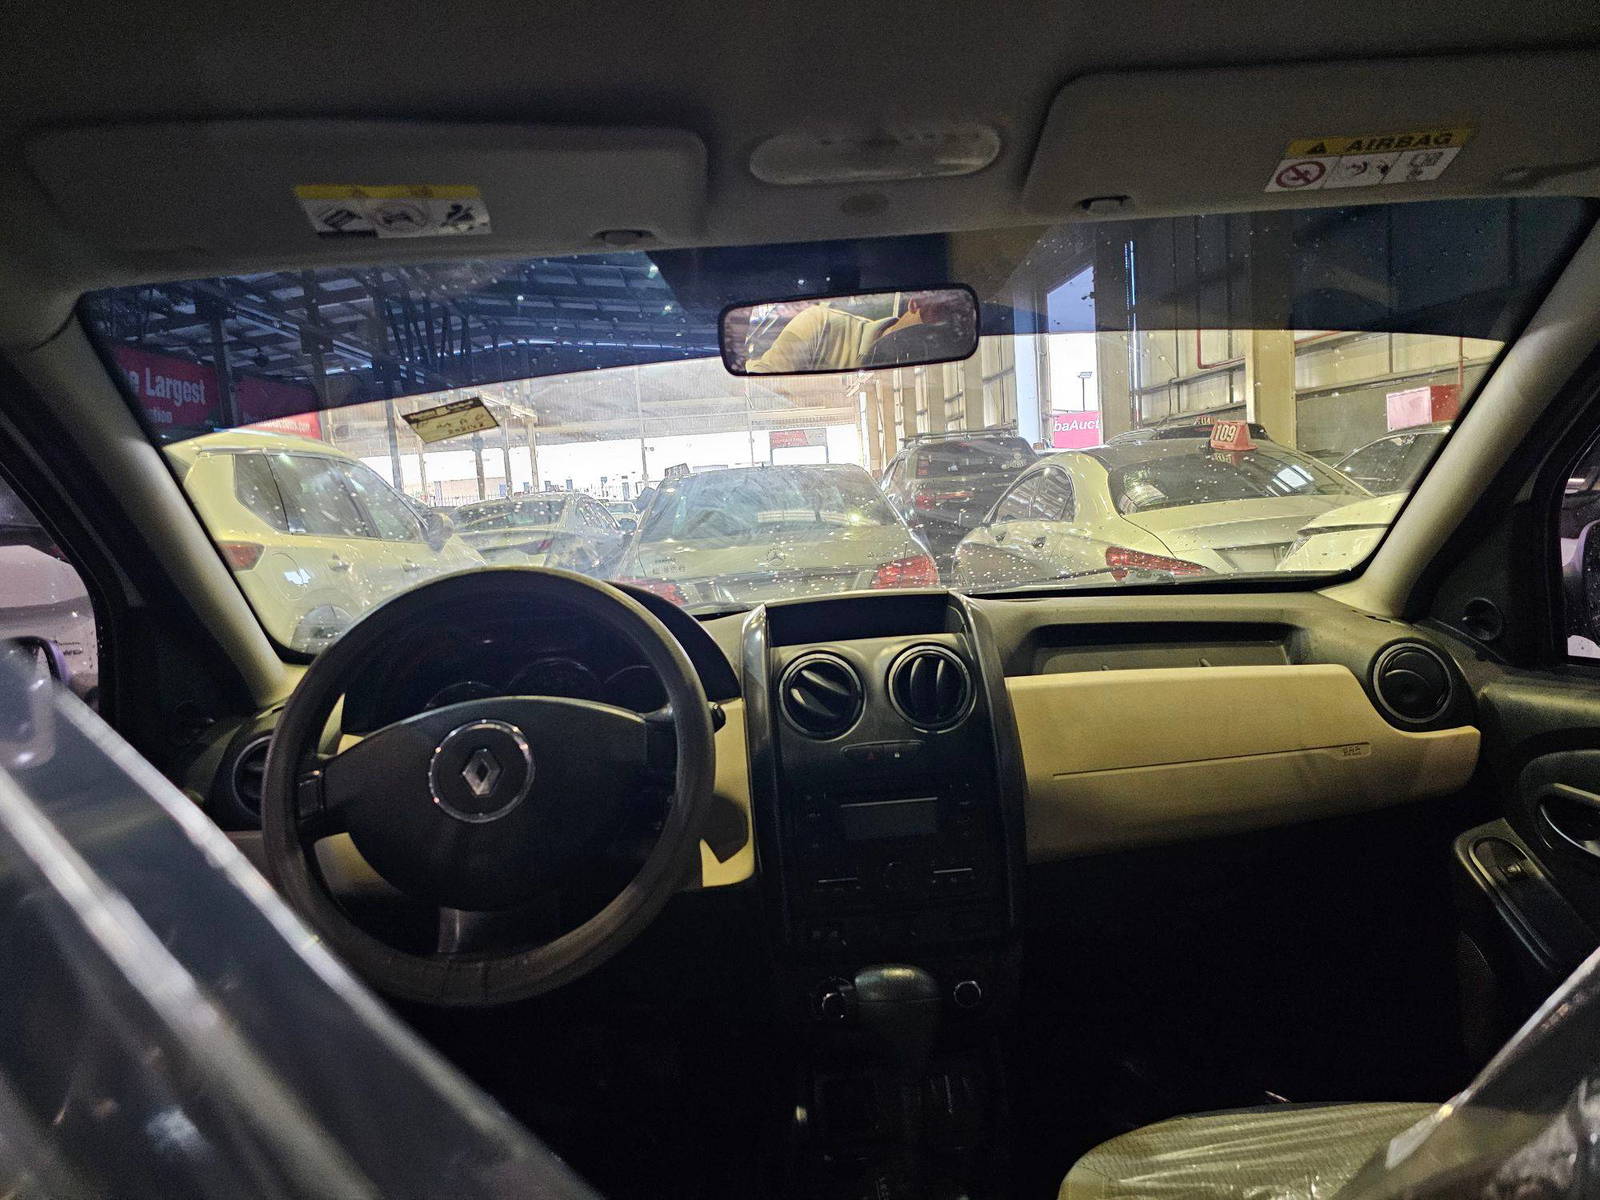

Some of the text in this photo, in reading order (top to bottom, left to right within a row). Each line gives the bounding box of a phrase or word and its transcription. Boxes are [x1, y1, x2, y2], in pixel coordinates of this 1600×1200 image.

[1344, 132, 1453, 152] AIRBAG
[145, 367, 206, 407] Largest
[1215, 424, 1237, 442] 109
